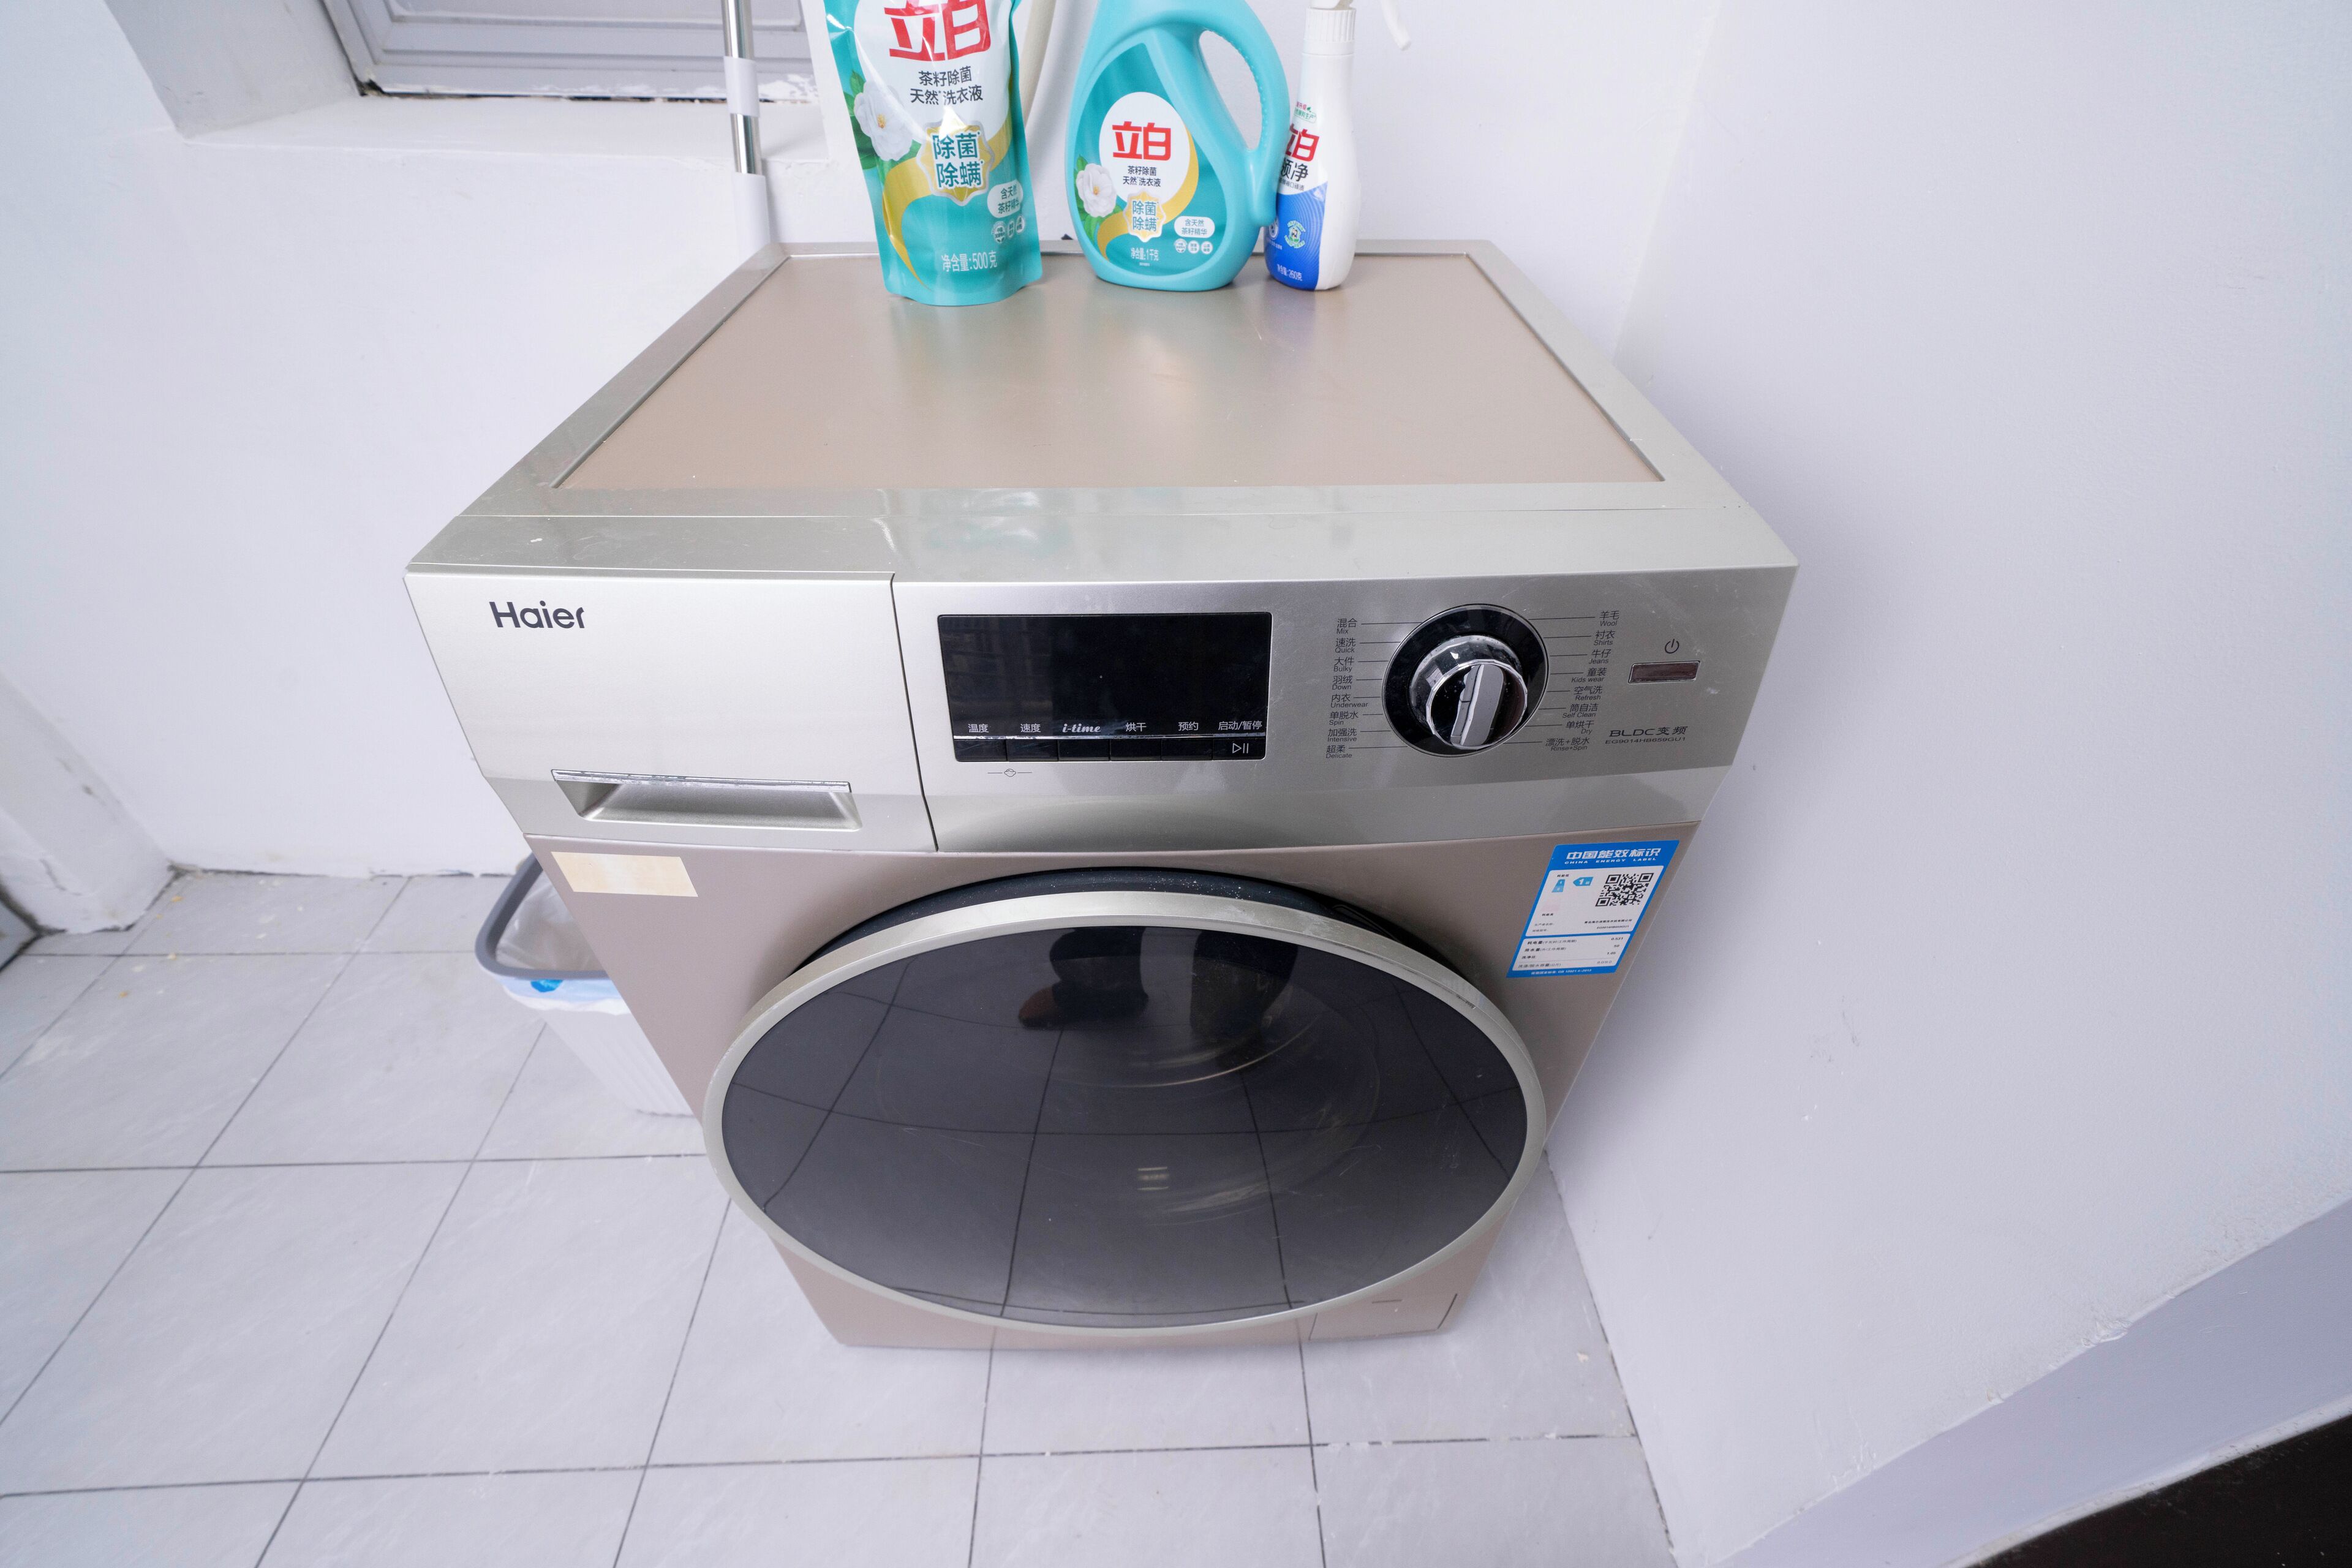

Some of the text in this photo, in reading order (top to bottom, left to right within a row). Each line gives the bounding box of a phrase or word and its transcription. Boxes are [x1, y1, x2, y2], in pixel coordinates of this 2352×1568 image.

[884, 0, 992, 61] 立白
[919, 66, 972, 86] 茶籽除菌
[932, 132, 978, 159] 除菌
[1112, 121, 1171, 161] 立白
[937, 162, 982, 188] 除螨
[1128, 165, 1157, 176] 茶籽除菌
[1133, 200, 1157, 216] 除菌
[1133, 216, 1158, 232] 除螨
[489, 600, 585, 628] Haier
[1599, 611, 1620, 620] 羊毛
[1337, 618, 1357, 628] 混合
[1595, 630, 1616, 639] 衬衣
[1335, 638, 1355, 647] 速洗
[1592, 649, 1611, 658] 牛仔
[1334, 657, 1354, 666] 大件
[1588, 668, 1607, 677] 童装
[1333, 676, 1352, 684] 羽绒
[1574, 686, 1602, 695] 空气洗
[1332, 693, 1351, 703] 内衣
[1569, 704, 1599, 712] 筒自洁
[1330, 711, 1359, 720] 单脱水
[968, 723, 989, 733] 温度
[1020, 723, 1041, 733] 速度
[1062, 723, 1101, 733] i-time
[1125, 722, 1147, 733] 烘干
[1178, 722, 1199, 731] 预约
[1218, 720, 1262, 731] 启动/暂停
[1566, 720, 1594, 729] 单烘干
[1656, 726, 1688, 736] 变频
[1326, 745, 1346, 753] 超柔
[1566, 848, 1661, 859] 中国能效标识
